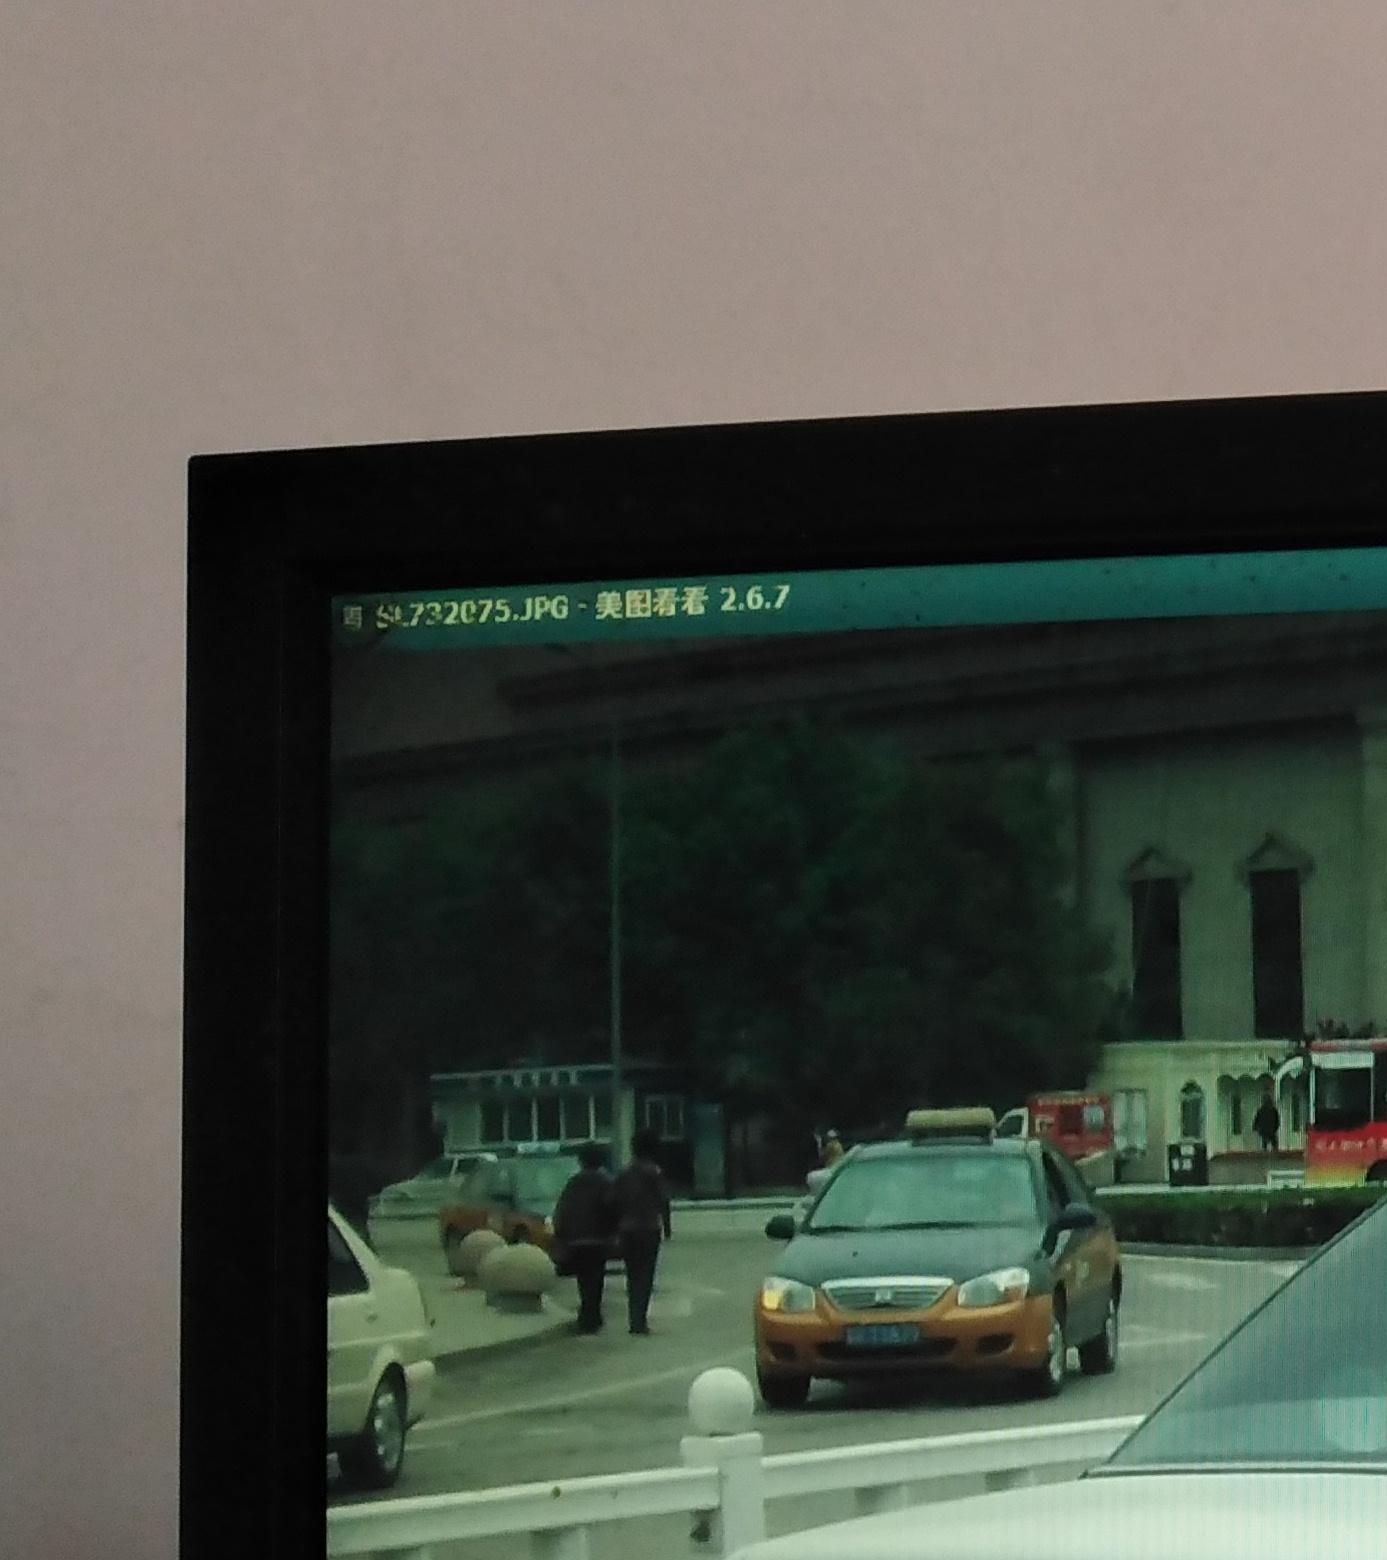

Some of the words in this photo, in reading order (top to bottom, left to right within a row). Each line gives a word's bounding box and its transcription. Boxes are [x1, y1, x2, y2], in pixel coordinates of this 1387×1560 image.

[595, 584, 709, 620] 美图看看
[720, 584, 791, 611] 2.6.7
